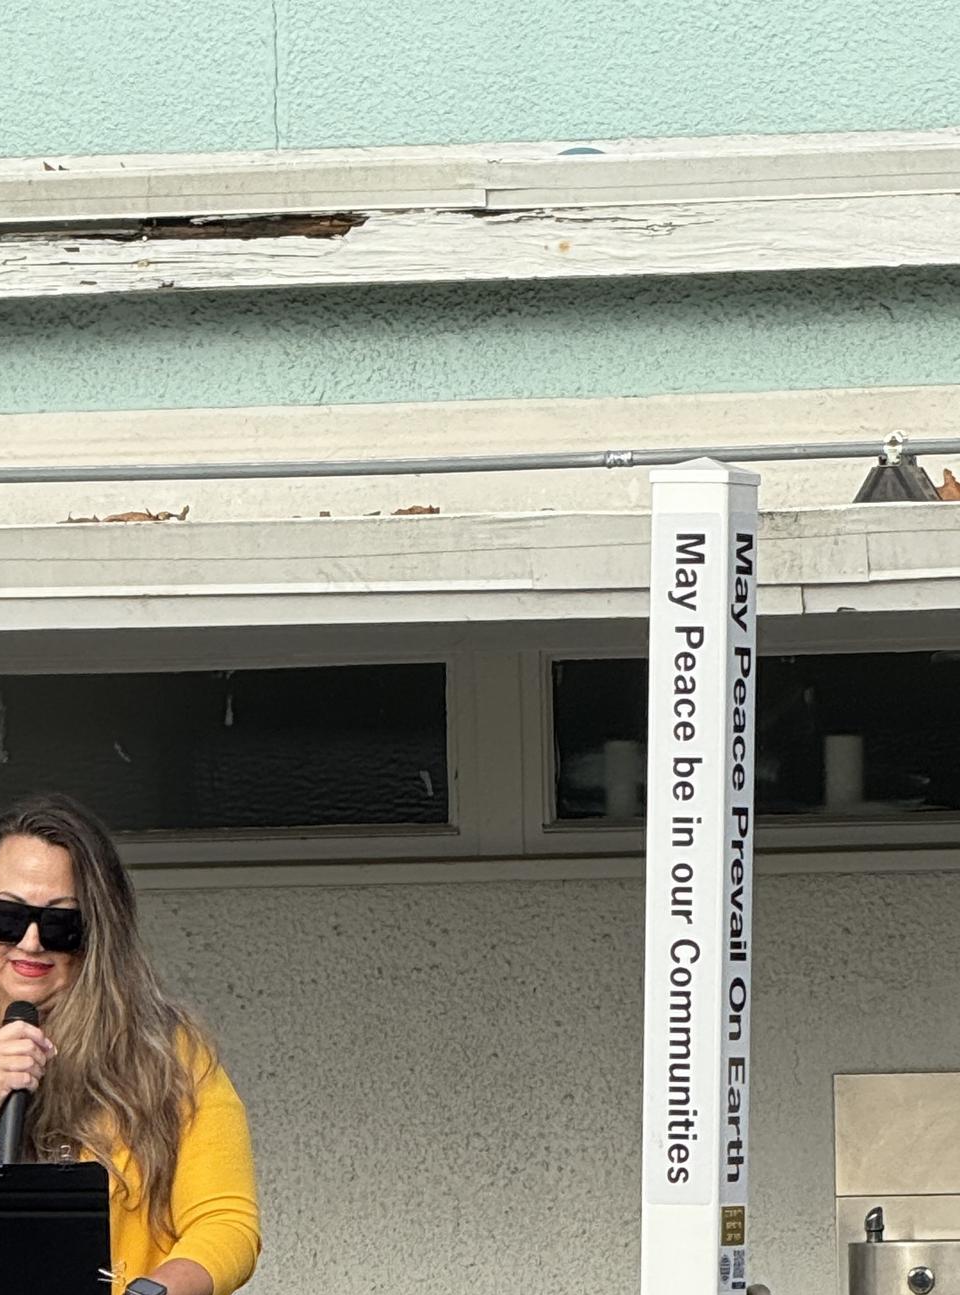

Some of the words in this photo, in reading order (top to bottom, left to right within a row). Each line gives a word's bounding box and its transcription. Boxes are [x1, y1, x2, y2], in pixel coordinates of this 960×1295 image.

[668, 533, 706, 611] May
[730, 532, 754, 633] May
[673, 626, 705, 741] Peace
[732, 646, 752, 792] Peace
[672, 757, 703, 801] be
[672, 817, 702, 847] in
[671, 863, 695, 925] our
[730, 806, 750, 962] Prevail
[728, 977, 747, 1041] On
[667, 939, 701, 1184] Communities
[726, 1057, 746, 1183] Earth
